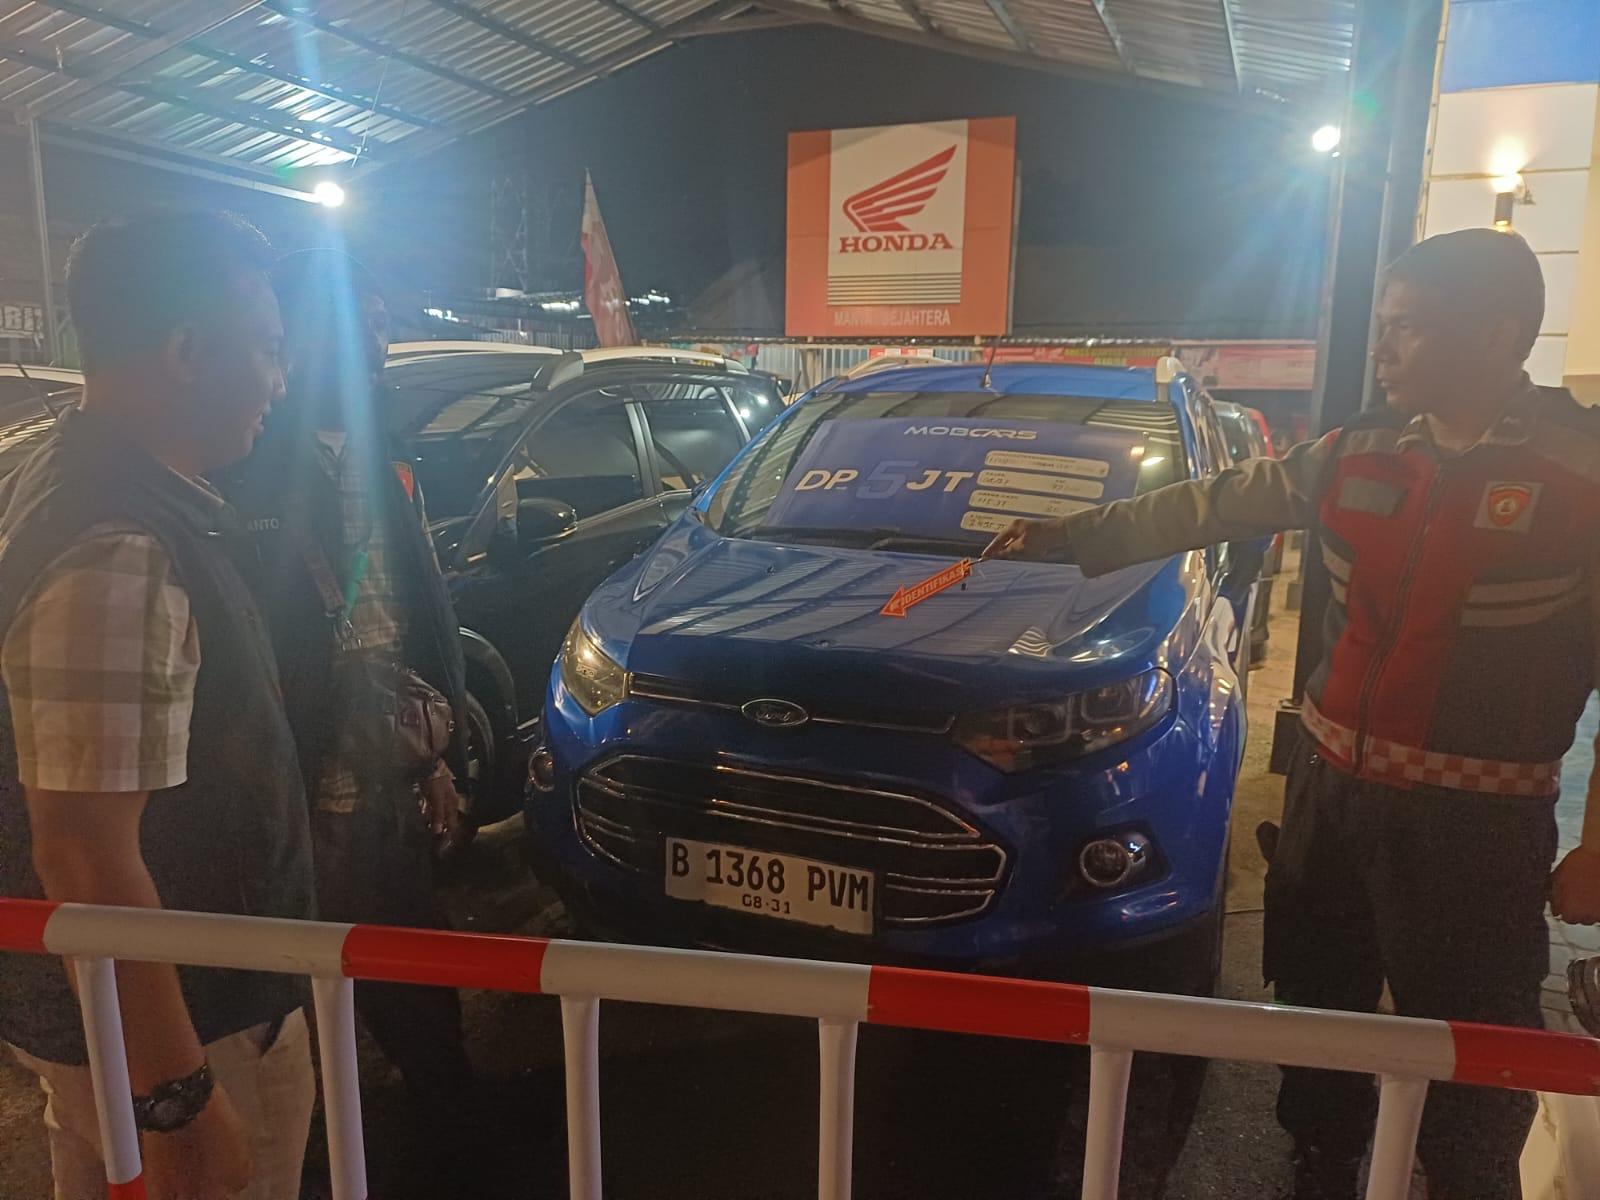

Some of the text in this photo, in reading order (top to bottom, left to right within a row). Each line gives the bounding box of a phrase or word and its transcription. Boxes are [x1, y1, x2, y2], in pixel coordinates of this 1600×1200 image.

[839, 233, 953, 253] HONDA
[904, 426, 1037, 440] MOBCARS
[856, 461, 918, 498] 5
[906, 470, 974, 491] JT
[672, 842, 869, 912] B 1368 PVM
